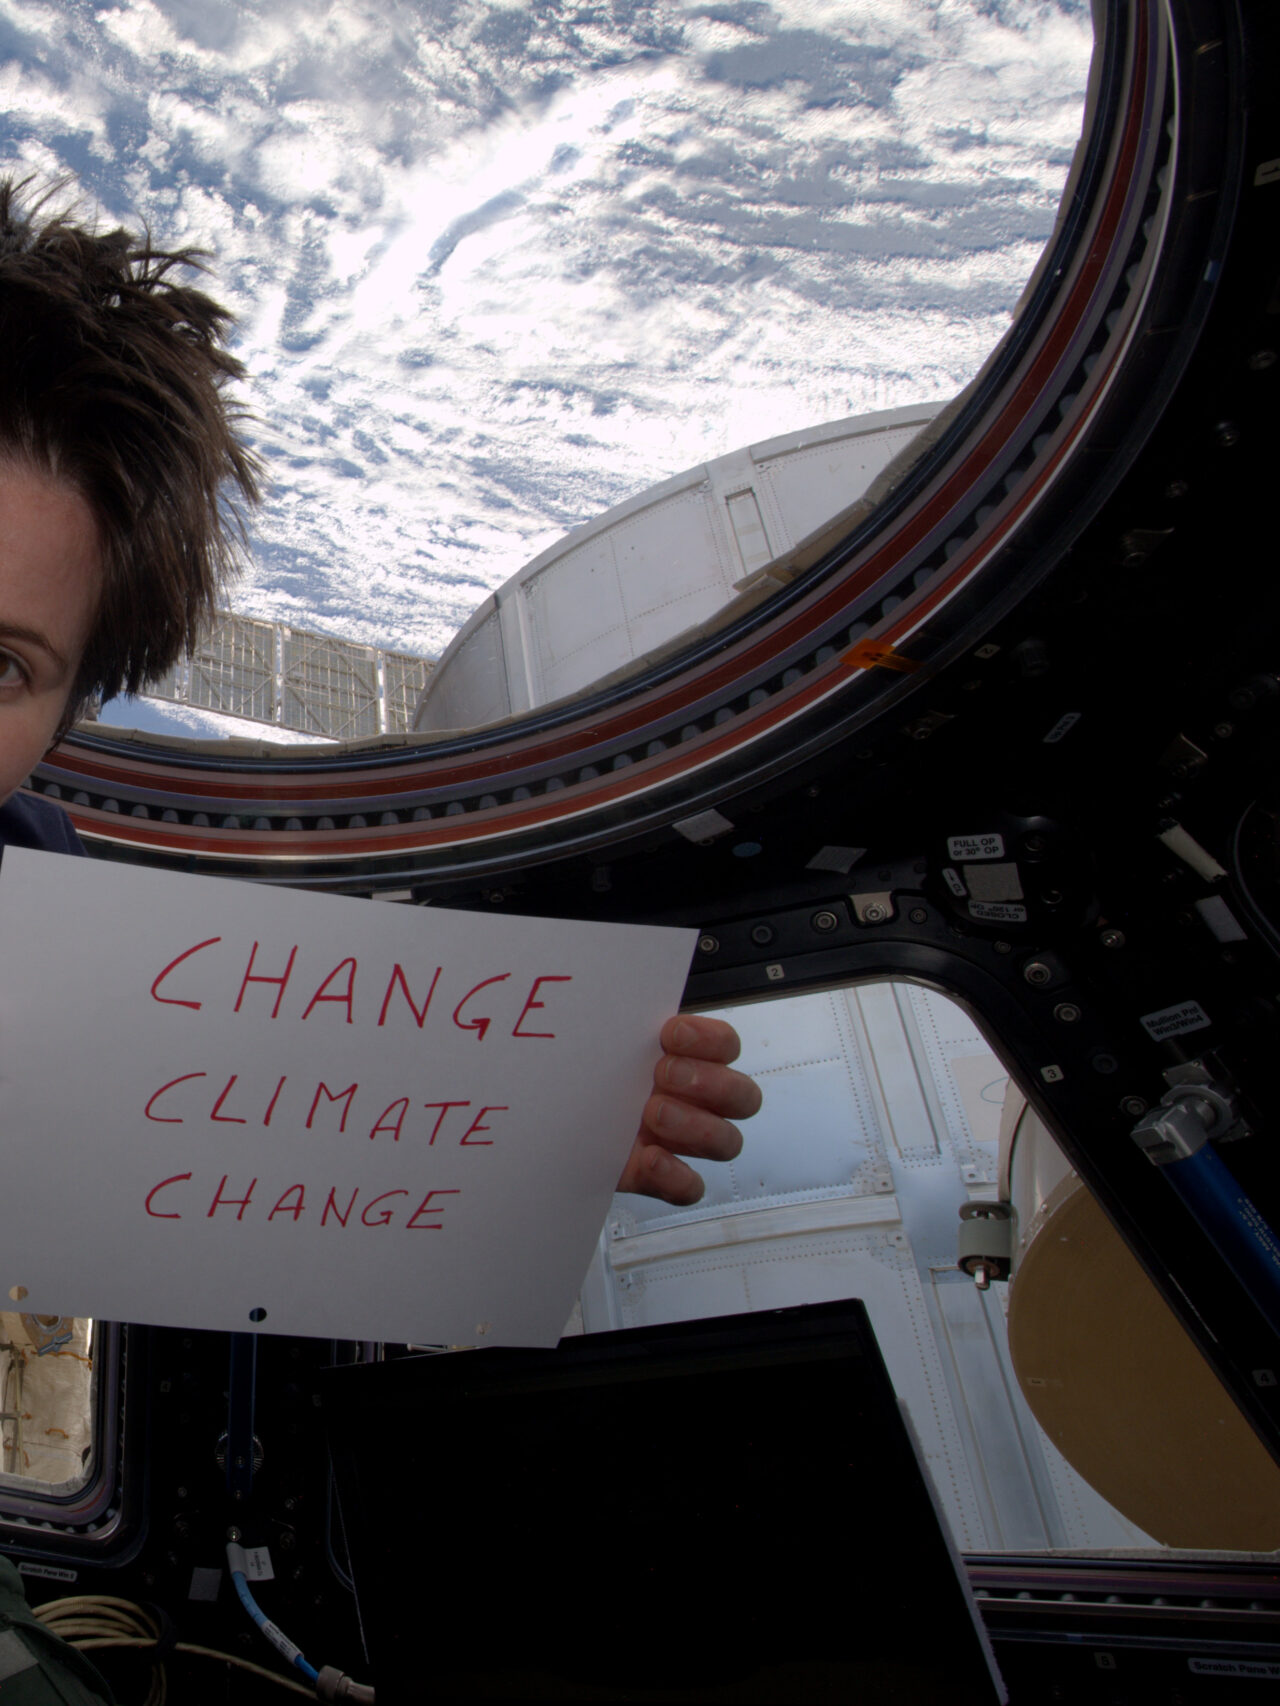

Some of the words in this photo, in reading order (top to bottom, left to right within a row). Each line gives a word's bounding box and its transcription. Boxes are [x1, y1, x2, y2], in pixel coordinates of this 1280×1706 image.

[953, 840, 978, 848] FULL
[981, 838, 995, 846] OP
[984, 846, 999, 854] OP
[771, 967, 778, 977] 2
[151, 937, 572, 1041] CHANGE
[1146, 1013, 1181, 1028] Mullion
[1182, 1006, 1199, 1016] Pnl
[1047, 1069, 1057, 1079] 3
[144, 1072, 508, 1146] CLIMATE
[145, 1172, 460, 1229] CHANGE
[1193, 1661, 1236, 1672] Scratch
[1239, 1664, 1267, 1674] Pane
